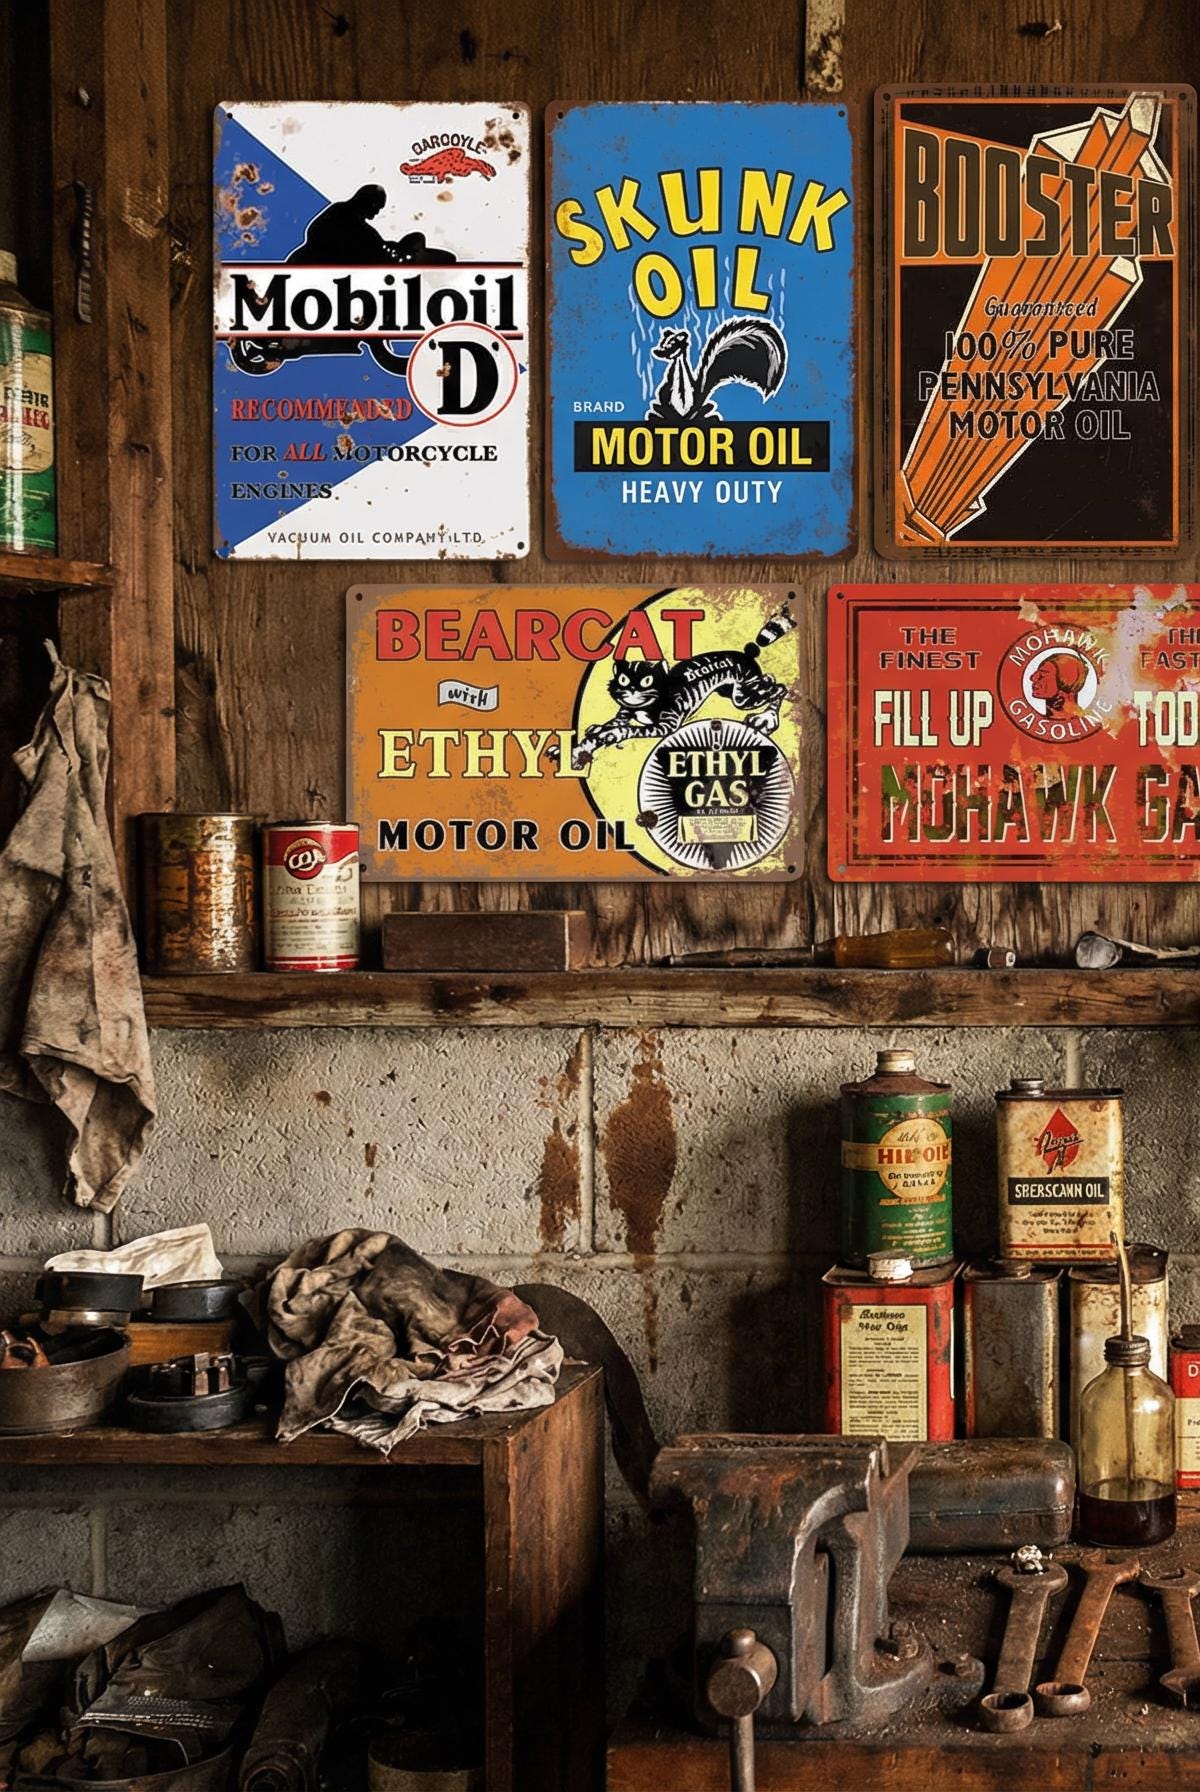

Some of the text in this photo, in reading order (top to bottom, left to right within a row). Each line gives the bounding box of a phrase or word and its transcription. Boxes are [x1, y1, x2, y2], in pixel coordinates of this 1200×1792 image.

[904, 126, 1174, 258] BOOSTER
[554, 167, 848, 266] SKUNK
[632, 245, 773, 318] OIL
[230, 274, 519, 332] Mobiloil
[944, 329, 1134, 361] 100% PURE
[918, 371, 1161, 402] PENNSYLVANIA
[573, 401, 625, 413] BRAND
[948, 410, 1132, 440] MOTOR OIL
[231, 442, 499, 463] FOR ALL MOTORCYCLE
[591, 427, 813, 466] MOTOR OIL
[231, 482, 333, 500] ENGINES
[622, 480, 703, 504] HEAVY
[339, 531, 365, 544] OIL
[376, 609, 706, 661] BEARCAT
[900, 627, 957, 645] THE
[1009, 629, 1112, 668] MOHAWK
[880, 650, 982, 670] FINEST
[872, 690, 993, 748] FILL UP
[1009, 699, 1113, 740] GASOLINE
[378, 730, 593, 779] ETHYL
[666, 750, 768, 778] ETHYL
[684, 780, 750, 808] GAS
[880, 764, 1118, 844] MOHAWK
[378, 819, 636, 853] MOTOR OIL
[1085, 1183, 1105, 1198] OIL
